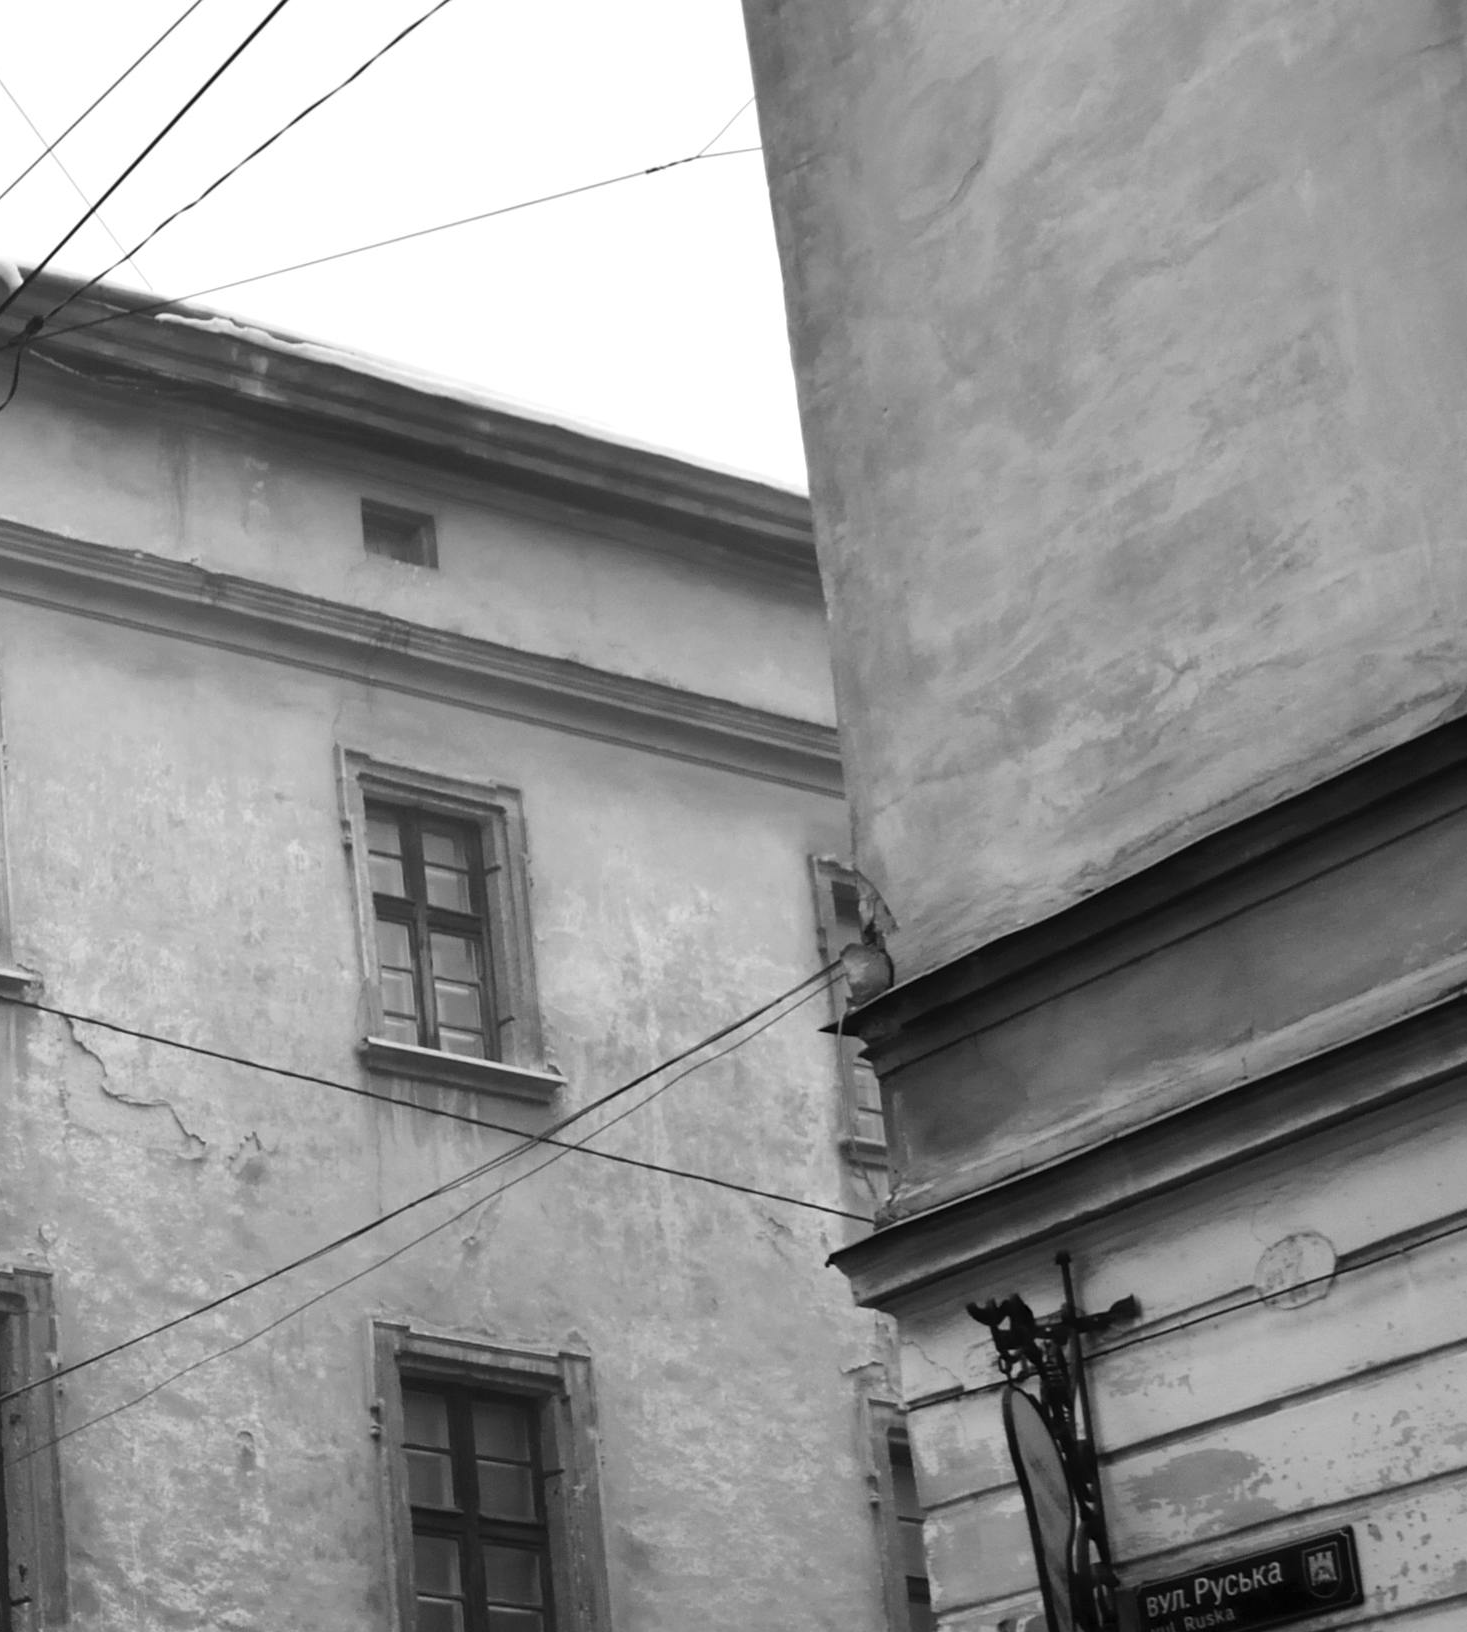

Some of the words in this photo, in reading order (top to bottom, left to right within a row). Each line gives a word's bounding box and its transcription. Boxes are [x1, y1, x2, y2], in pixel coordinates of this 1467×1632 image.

[1146, 1588, 1190, 1618] вул.
[1193, 1560, 1283, 1606] Руська
[1183, 1605, 1236, 1632] Ruska
